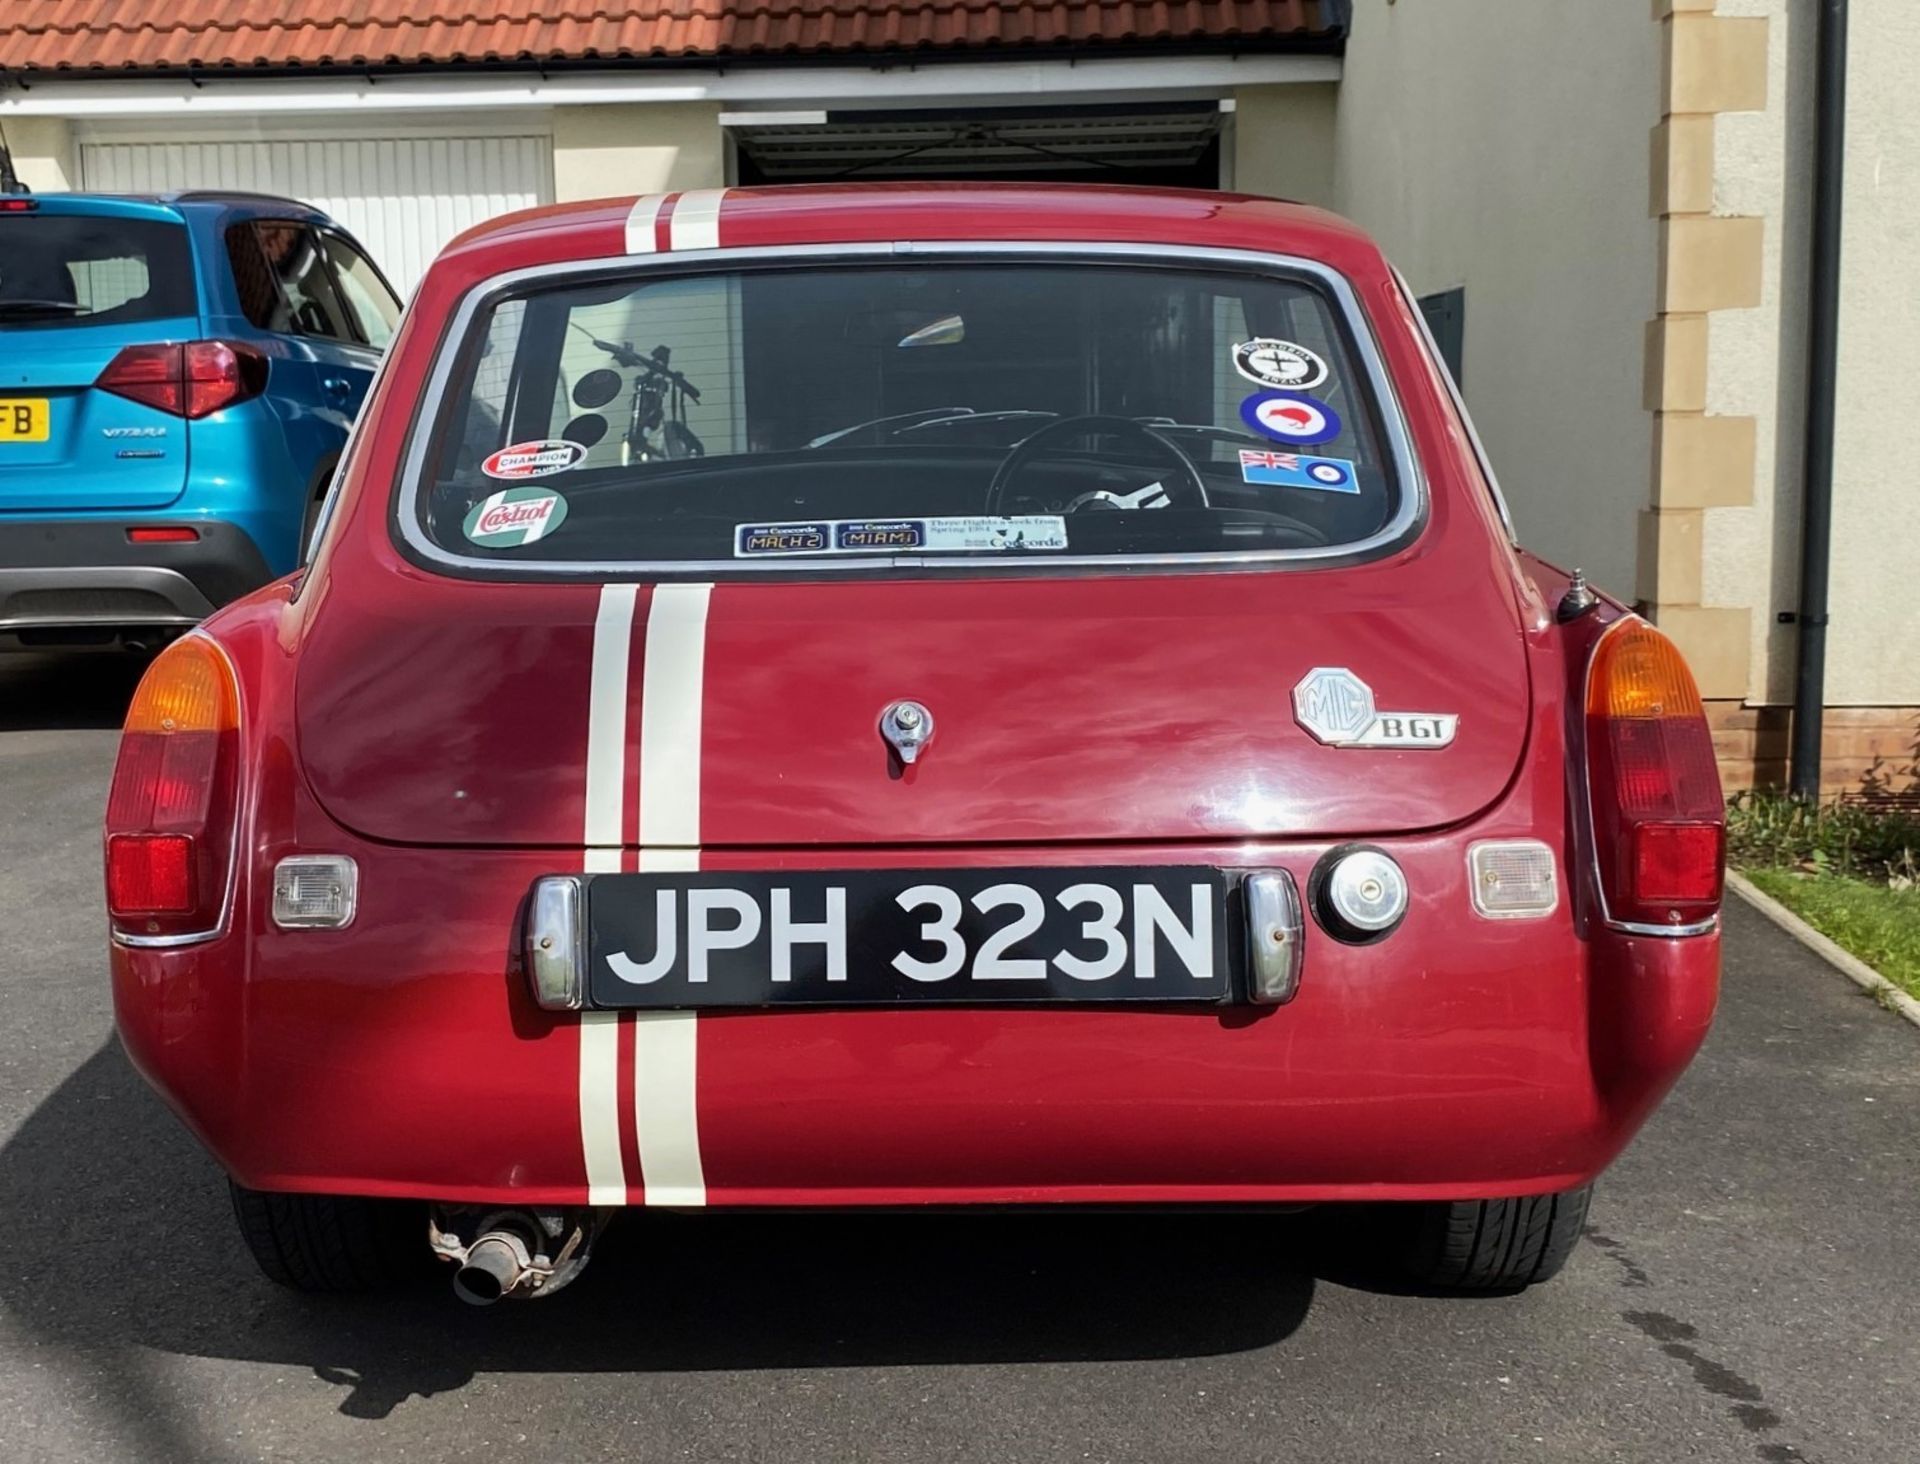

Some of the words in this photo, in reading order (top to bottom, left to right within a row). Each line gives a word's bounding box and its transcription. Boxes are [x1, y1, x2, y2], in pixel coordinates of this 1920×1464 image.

[102, 427, 167, 437] VITARA
[500, 452, 569, 467] CHAMPION
[480, 499, 554, 533] Castrol
[750, 536, 803, 549] MACH
[806, 535, 820, 546] 2
[850, 532, 912, 545] MIAMI
[1303, 677, 1368, 731] MG
[605, 887, 847, 984] JPH
[890, 883, 1214, 982] 323N
